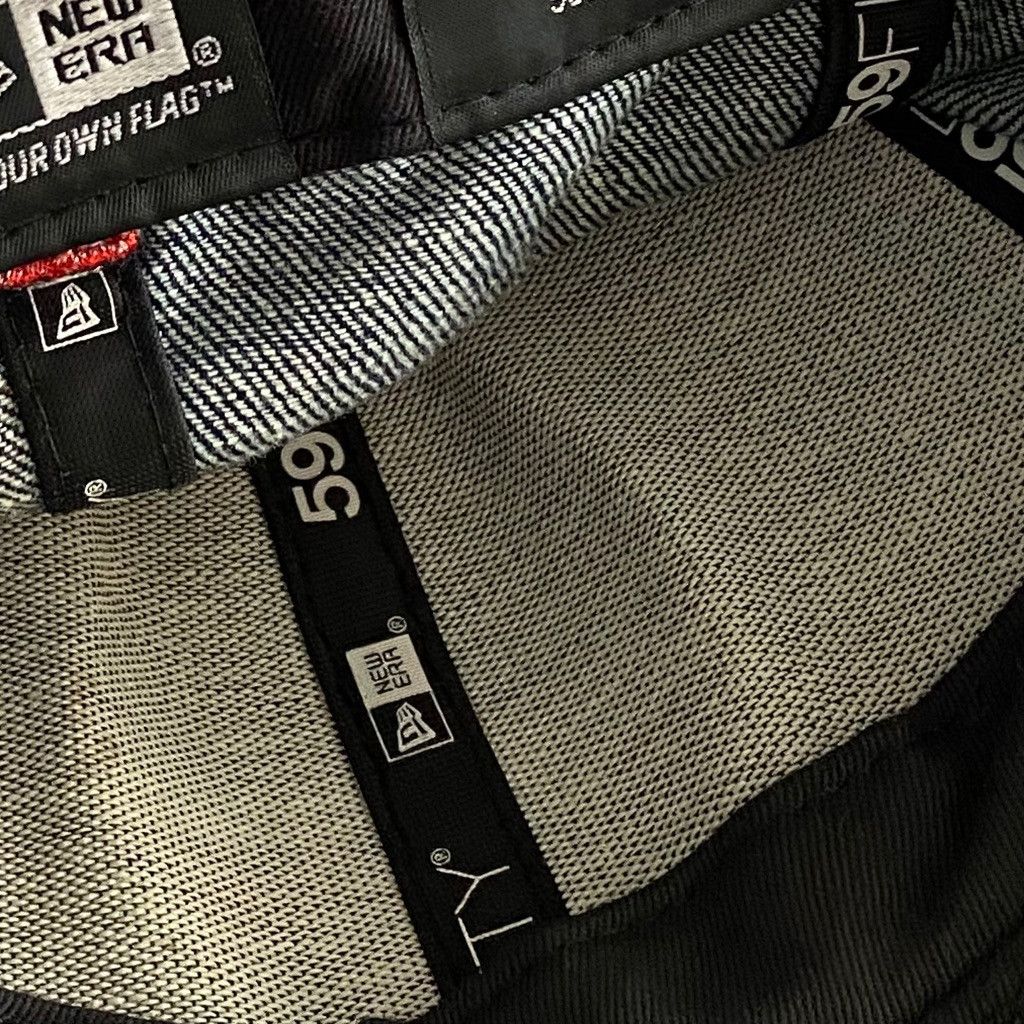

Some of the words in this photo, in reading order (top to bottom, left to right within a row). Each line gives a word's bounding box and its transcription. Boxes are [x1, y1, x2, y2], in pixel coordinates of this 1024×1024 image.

[52, 22, 157, 87] ERA
[52, 110, 124, 166] OWN
[280, 430, 362, 524] 59
[363, 651, 394, 696] NEW
[383, 645, 412, 689] ERA
